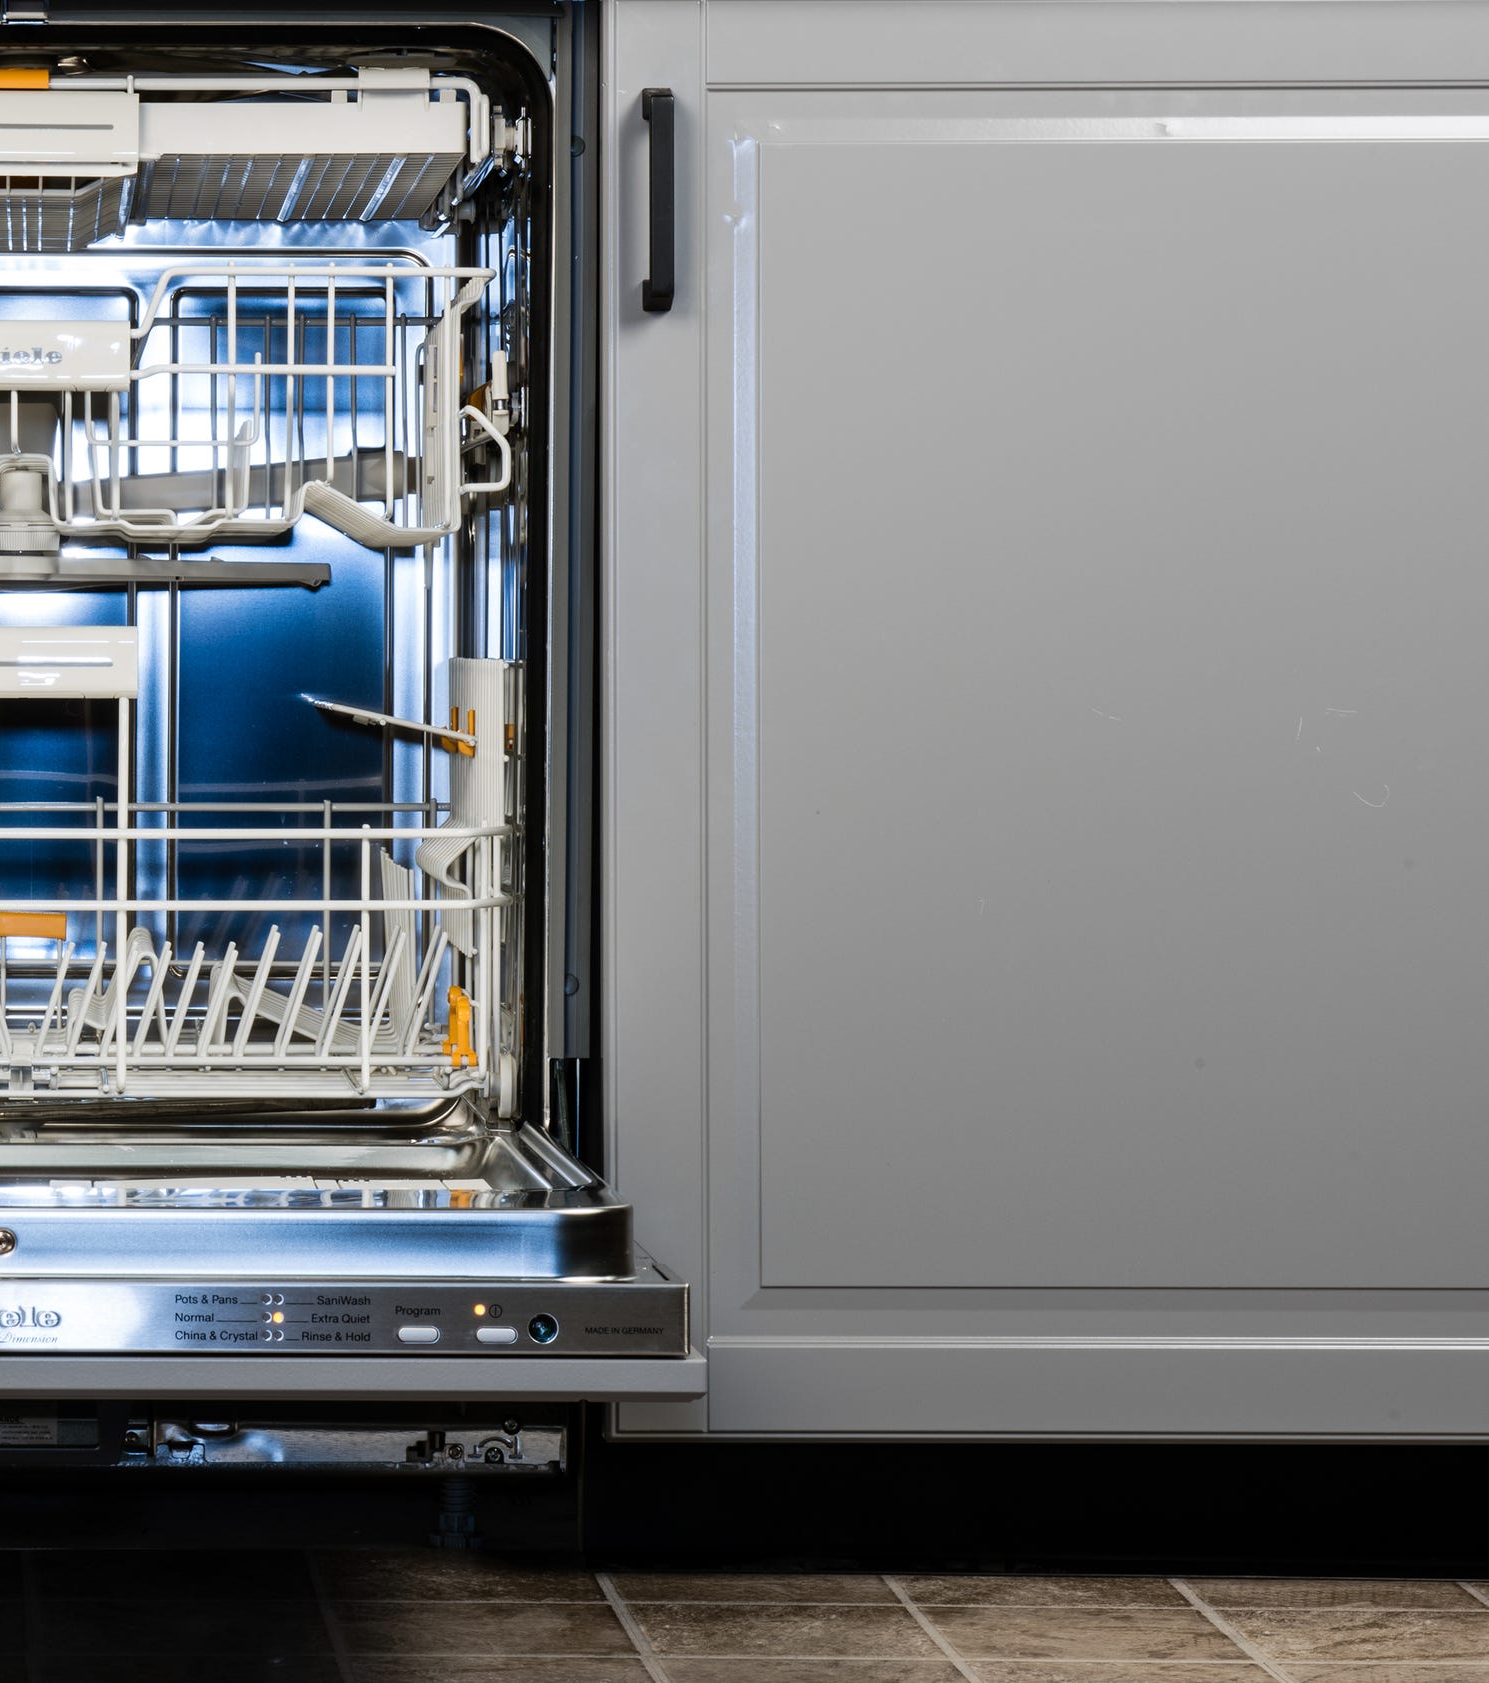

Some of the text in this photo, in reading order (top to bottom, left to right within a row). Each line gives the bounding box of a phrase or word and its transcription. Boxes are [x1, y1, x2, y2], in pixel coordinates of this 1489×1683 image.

[174, 1294, 238, 1305] Pots & Pans
[317, 1295, 371, 1306] SaniWash
[174, 1311, 215, 1323] Normal
[395, 1306, 441, 1317] Program
[311, 1313, 371, 1325] Extra Quiet
[174, 1330, 258, 1343] China & Crystal
[301, 1331, 371, 1342] Rinse & Hold
[584, 1327, 664, 1335] MADE IN GERMANY
